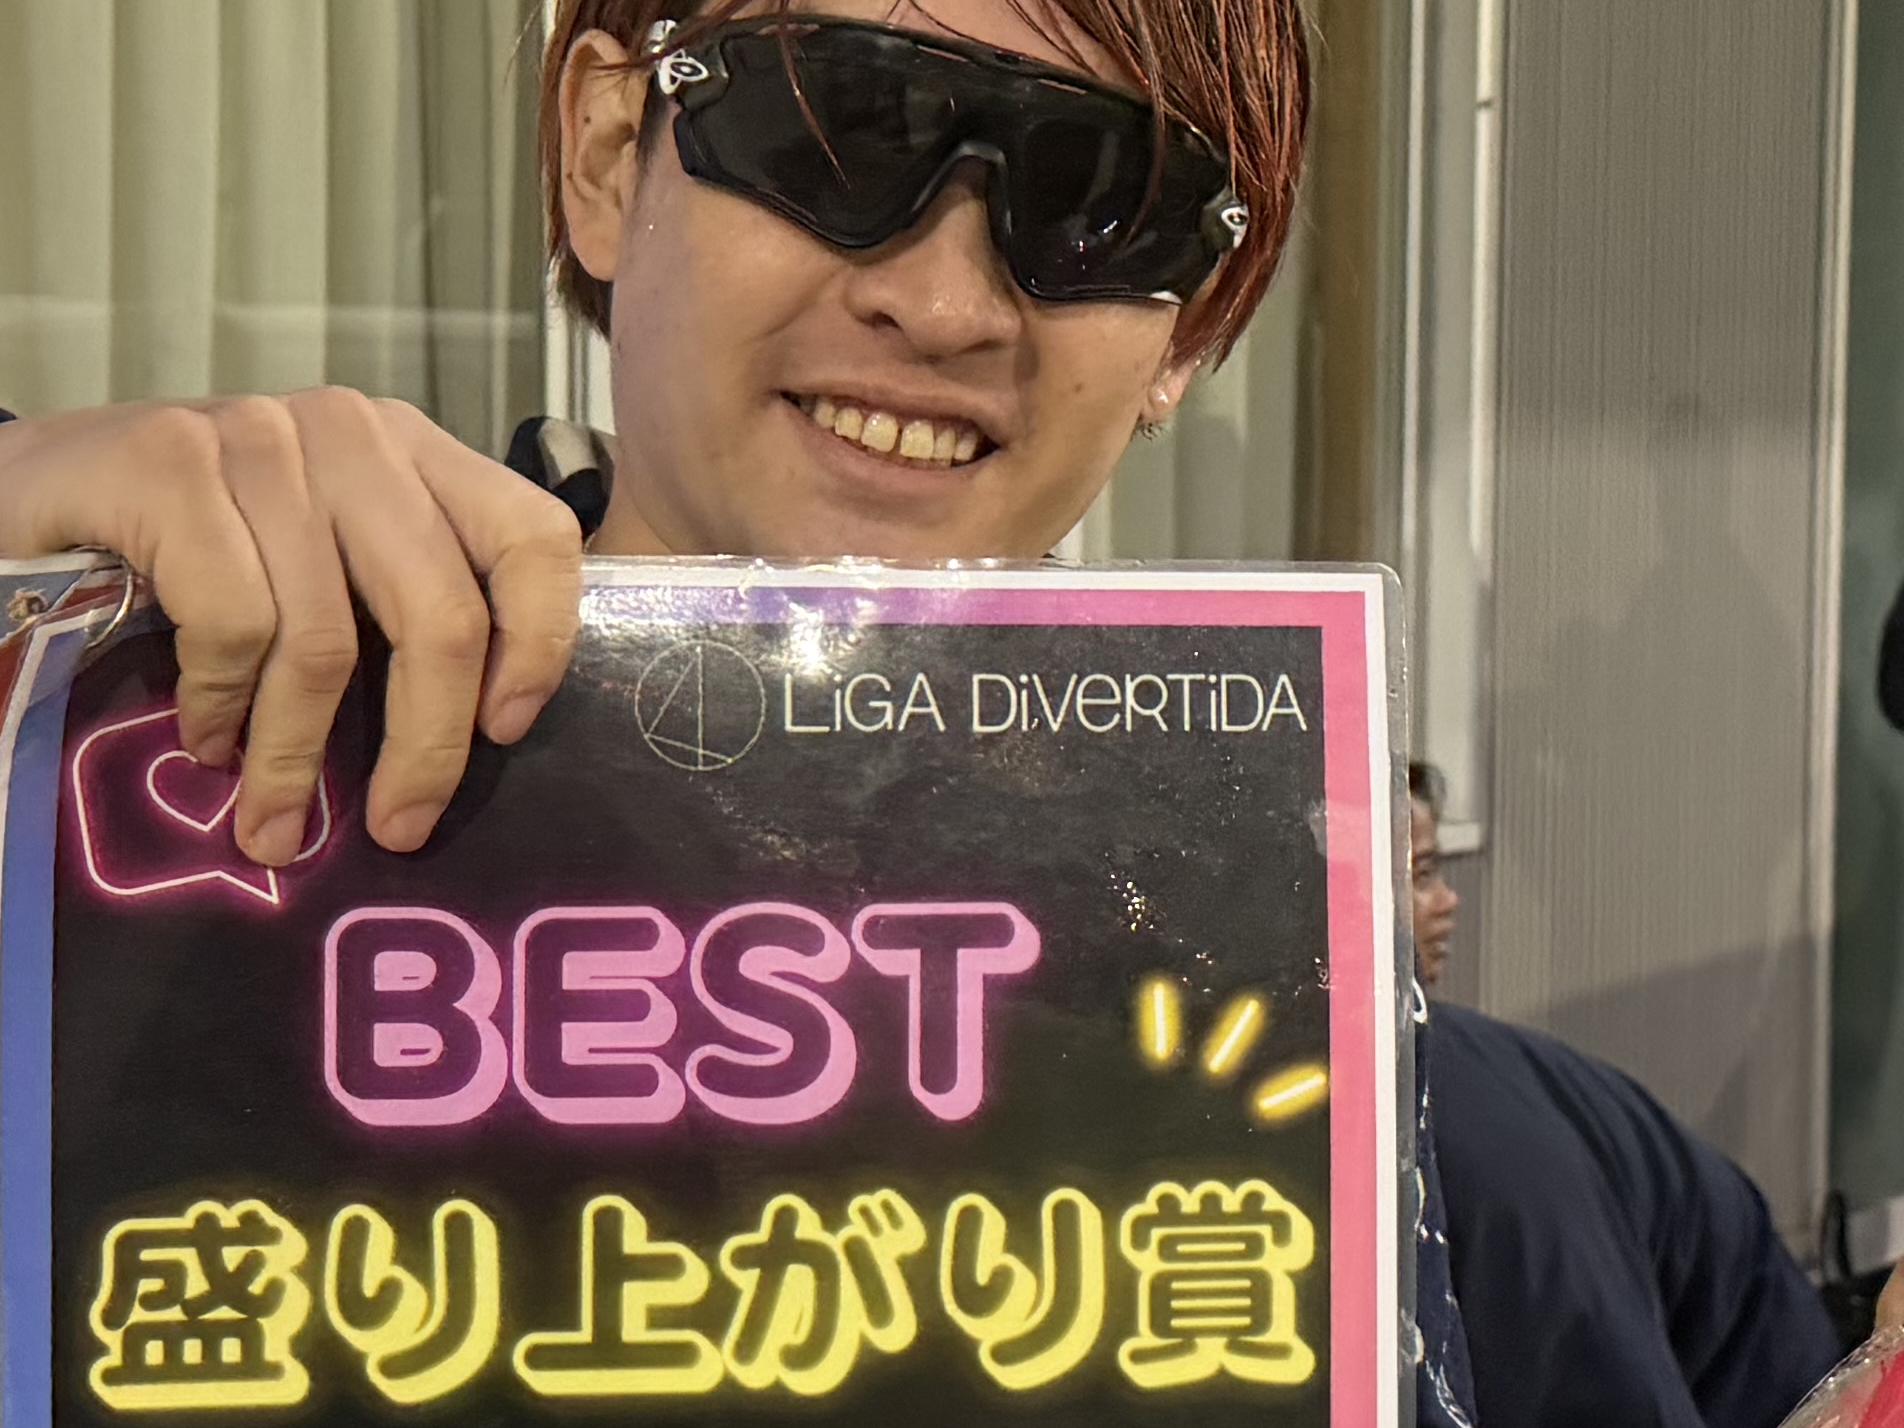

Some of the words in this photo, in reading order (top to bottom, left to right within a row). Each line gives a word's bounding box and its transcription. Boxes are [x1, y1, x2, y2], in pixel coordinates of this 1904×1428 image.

[320, 898, 1044, 1129] BEST
[88, 1176, 1321, 1414] 盛り上がり賞
